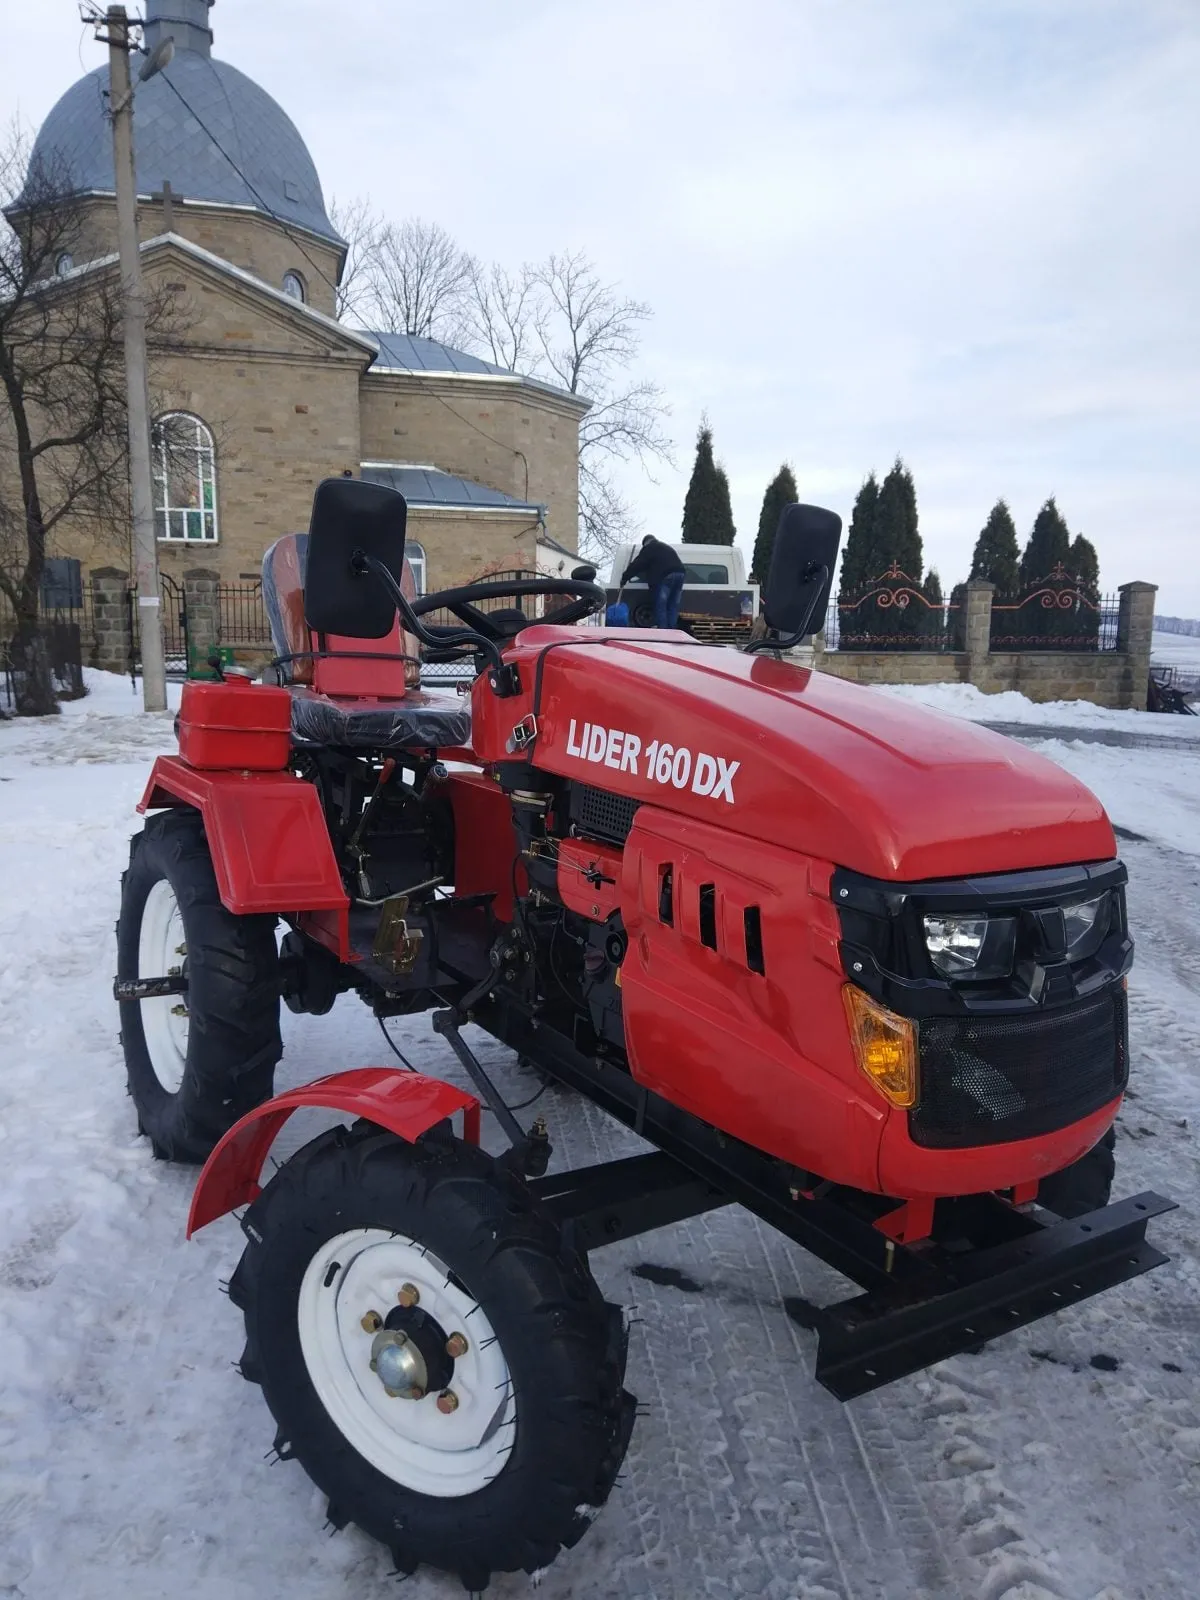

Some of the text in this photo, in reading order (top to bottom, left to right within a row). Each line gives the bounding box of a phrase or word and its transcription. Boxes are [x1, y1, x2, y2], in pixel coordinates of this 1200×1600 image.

[566, 719, 740, 804] LIDER 160 DX
